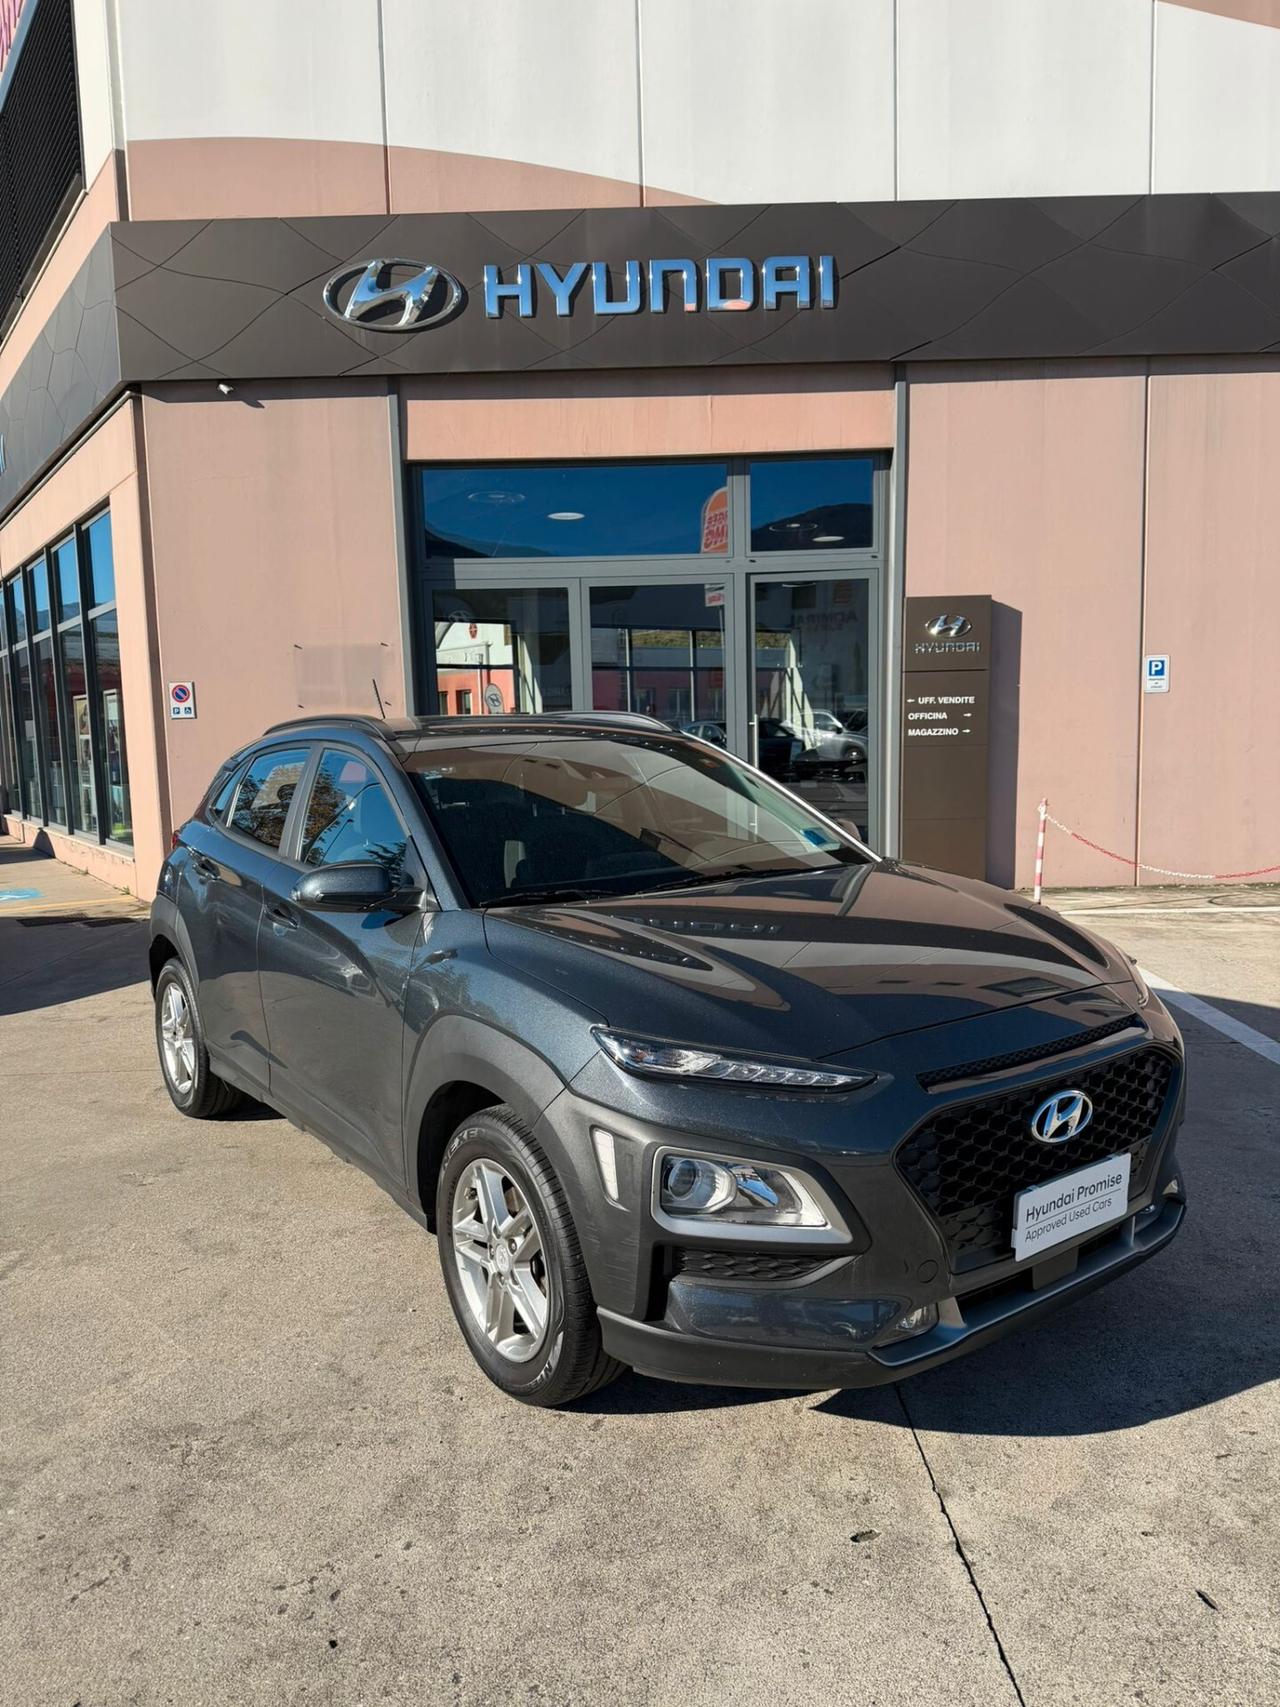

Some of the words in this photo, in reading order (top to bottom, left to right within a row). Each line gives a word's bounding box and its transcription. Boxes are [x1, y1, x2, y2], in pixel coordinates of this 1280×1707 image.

[484, 255, 835, 319] HYUNDAI
[915, 642, 980, 653] HYUNDAI
[1151, 661, 1163, 675] P
[938, 696, 975, 704] VENDITE
[908, 712, 948, 720] OFFICINA
[908, 728, 959, 737] MAGAZZINO
[1025, 1188, 1076, 1223] Hyundai
[1076, 1174, 1122, 1200] Promise
[1025, 1213, 1067, 1243] Approved
[1069, 1203, 1092, 1223] Used
[1092, 1197, 1113, 1213] Cars
